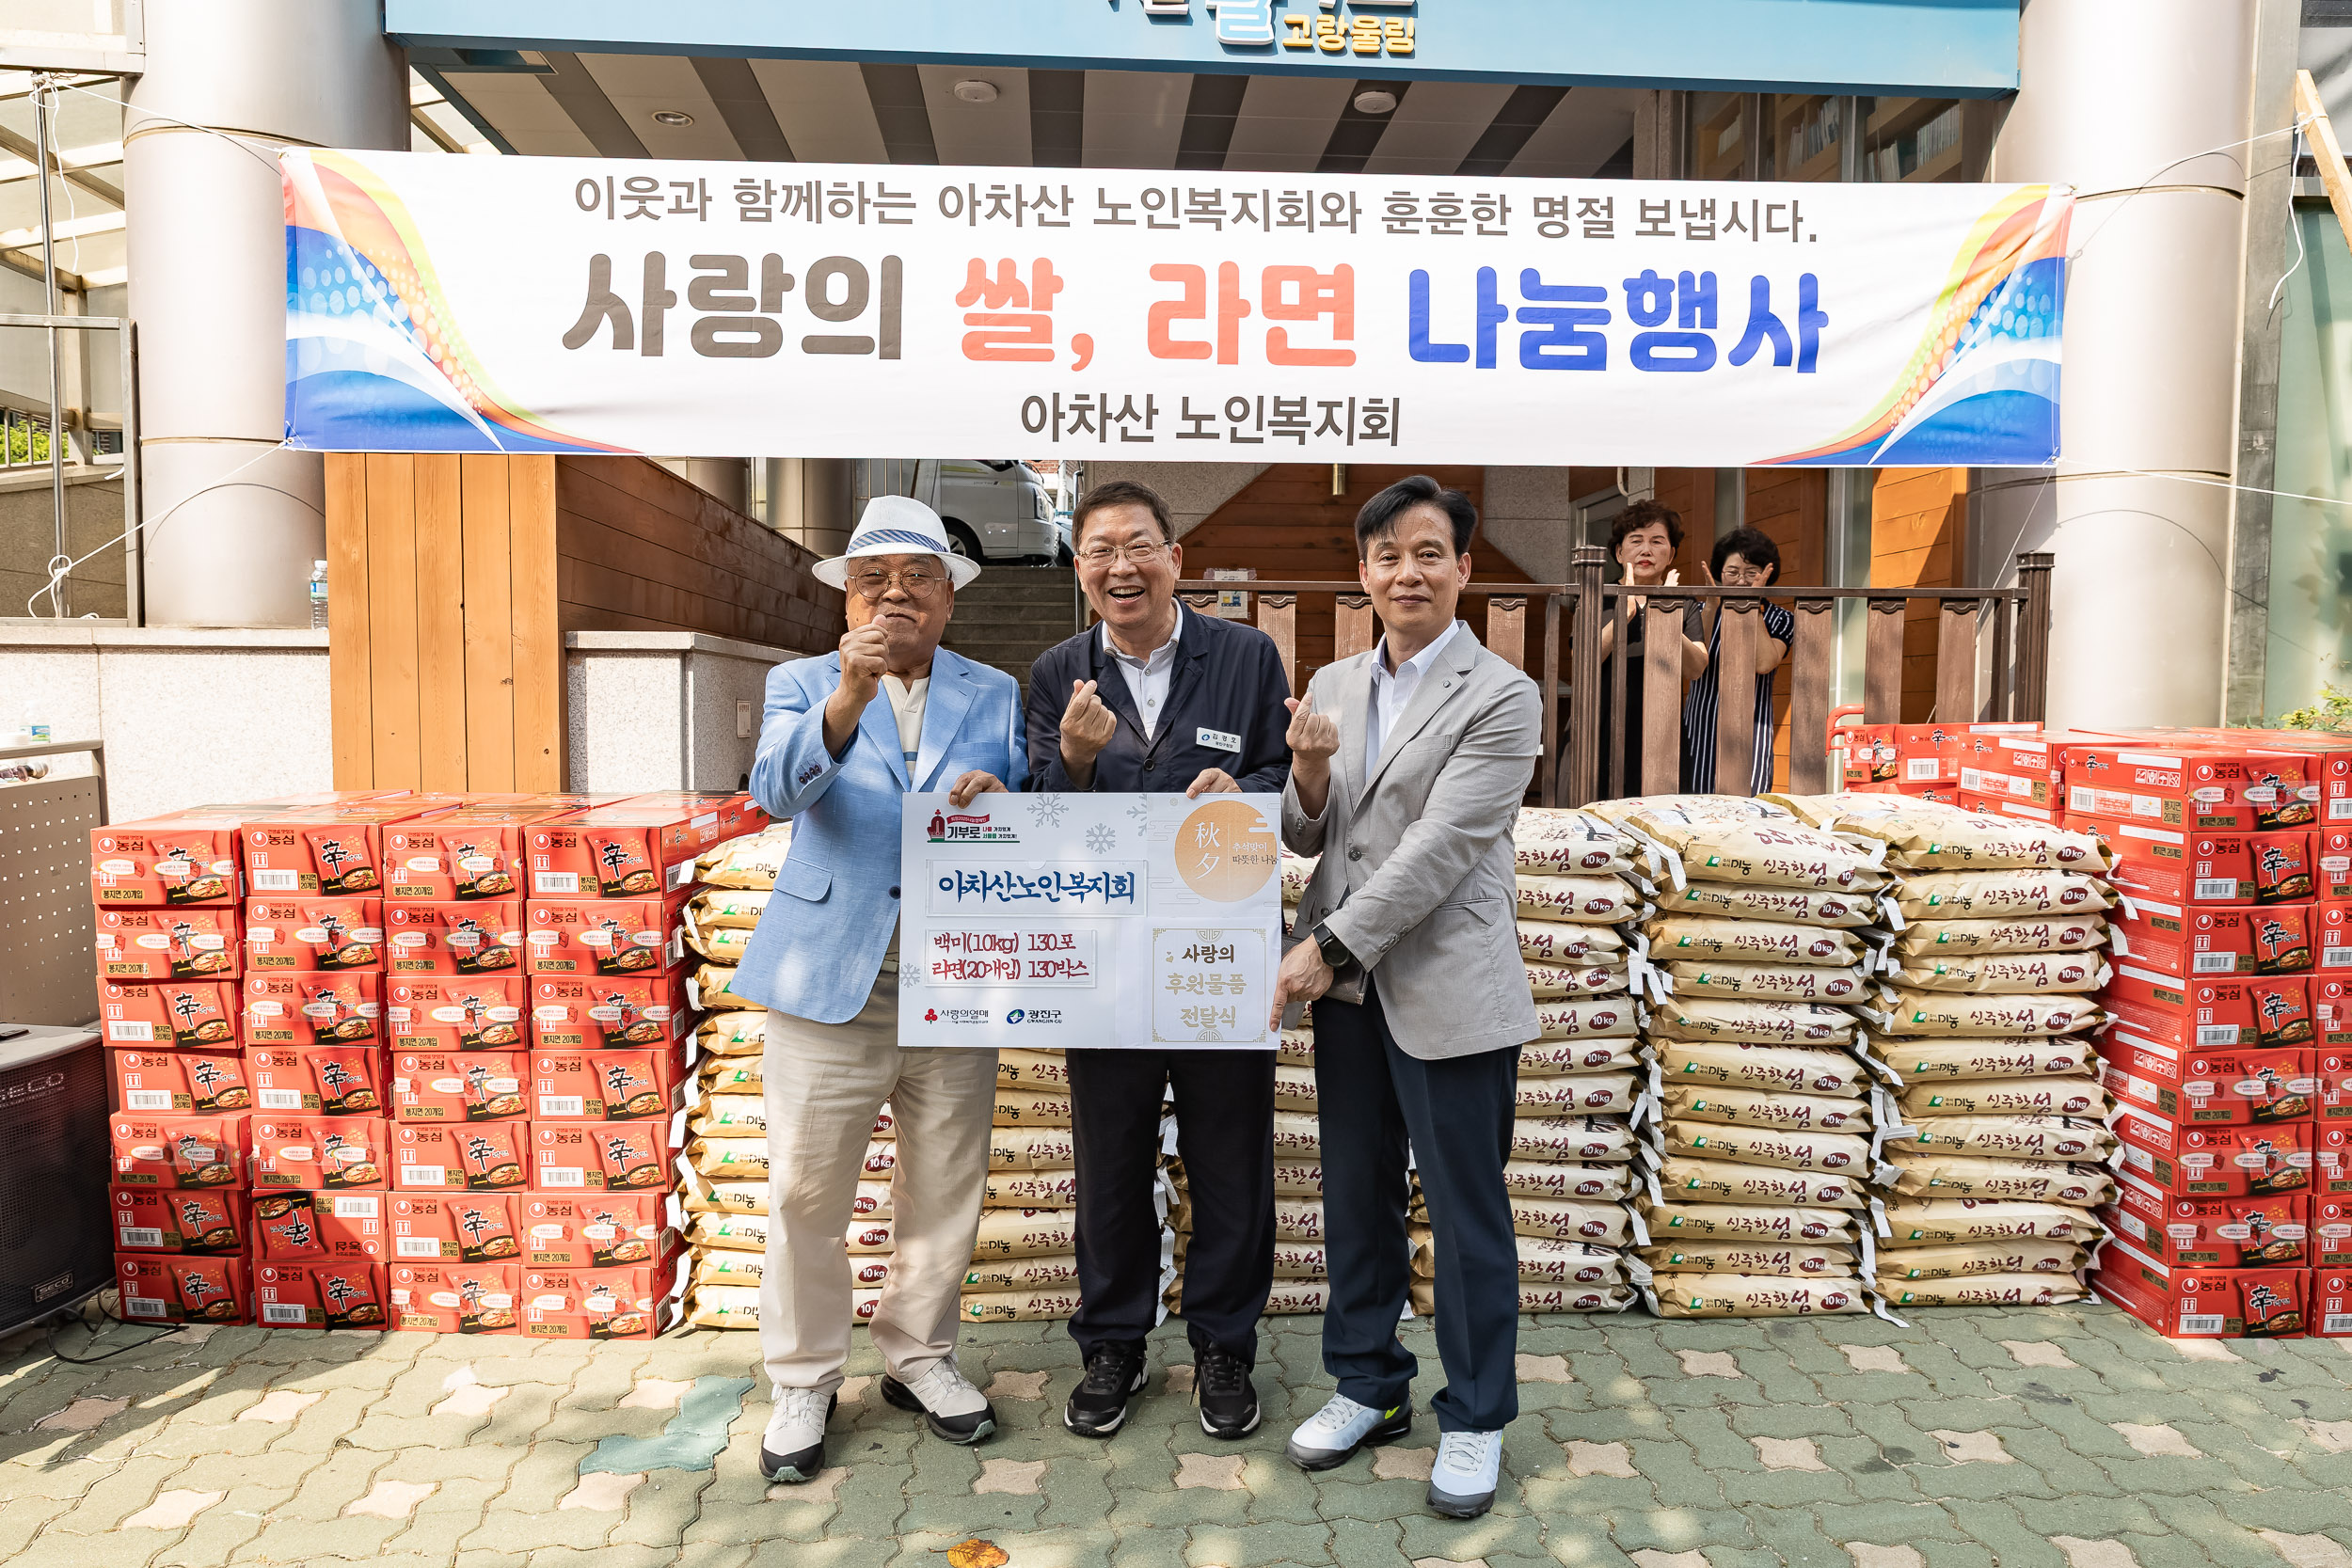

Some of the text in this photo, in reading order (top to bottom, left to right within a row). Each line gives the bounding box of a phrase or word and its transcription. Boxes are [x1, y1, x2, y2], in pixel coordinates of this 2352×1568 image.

[1282, 14, 1414, 54] 고랑울림
[575, 176, 1817, 245] 이웃과 함께하는 아차산 노인복지회와 훈훈한 명절 보냅시다.
[562, 250, 1829, 373] 사랑의 쌀, 라면 나눔행사
[1021, 393, 1400, 448] 아차산 노인복지회
[2215, 768, 2240, 779] 농심
[2164, 801, 2182, 811] 봉지면
[2164, 813, 2181, 824] 20개입
[2200, 817, 2235, 826] 봉지면 20개입
[947, 827, 980, 838] 기부로
[268, 833, 294, 846] 농심
[408, 837, 435, 848] 농심
[550, 837, 577, 848] 농심
[117, 840, 143, 851] 농심
[1193, 821, 1220, 880] 秋夕
[1232, 843, 1266, 852] 추석맞이
[2216, 844, 2240, 854] 농심
[2061, 847, 2083, 860] 10kg
[1232, 855, 1279, 864] 따뜻한 나눔
[1584, 855, 1607, 865] 10kg
[395, 886, 433, 895] 봉지면 20개입
[939, 870, 1136, 905] 아차산노인복지회
[103, 890, 143, 899] 봉지면 20개입
[2063, 891, 2086, 902] 10kg
[1588, 900, 1611, 911] 10kg
[1823, 905, 1844, 916] 10kg
[268, 907, 295, 919] 농심
[408, 912, 435, 924] 농심
[551, 912, 578, 923] 농심
[2063, 930, 2082, 942] 10kg
[933, 932, 1076, 954] 백미(10kg) 130포
[1813, 942, 1833, 954] 10kg
[1181, 943, 1235, 964] 사랑의
[256, 957, 295, 966] 봉지면 20개입
[931, 958, 1089, 980] 라면(20개입) 130박스
[2061, 969, 2084, 980] 10kg
[267, 982, 294, 993] 농심
[1165, 973, 1248, 996] 후원물품
[1829, 982, 1850, 993] 10kg
[556, 988, 583, 998] 농심
[2216, 990, 2241, 1001] 농심
[940, 1009, 989, 1020] 사랑의열매
[1027, 1009, 1061, 1019] 광진구
[1180, 1005, 1237, 1029] 전달식
[2050, 1015, 2070, 1027] 10kg
[543, 1035, 581, 1044] 봉지면 20개입
[141, 1054, 167, 1067] 농심
[1588, 1053, 1608, 1064] 10kg
[555, 1061, 581, 1072] 농심
[2049, 1060, 2071, 1069] 10kg
[2210, 1063, 2234, 1073] 농심
[1818, 1077, 1839, 1089] 10kg
[1588, 1093, 1610, 1103] 10kg
[2066, 1099, 2087, 1111] 10kg
[276, 1127, 302, 1138] 농심
[417, 1132, 443, 1142] 농심
[556, 1132, 582, 1143] 농심
[2058, 1143, 2082, 1153] 10kg
[869, 1158, 892, 1168] 10kg
[1827, 1153, 1847, 1165] 10kg
[1579, 1183, 1600, 1194] 10kg
[1820, 1188, 1842, 1200] 10kg
[547, 1204, 572, 1215] 농심
[2196, 1205, 2222, 1215] 농심
[863, 1231, 885, 1243] 10kg
[532, 1253, 570, 1262] 봉지면 20개입
[278, 1270, 303, 1281] 농심
[544, 1277, 569, 1288] 농심
[2201, 1280, 2226, 1291] 농심
[1825, 1295, 1846, 1307] 10kg
